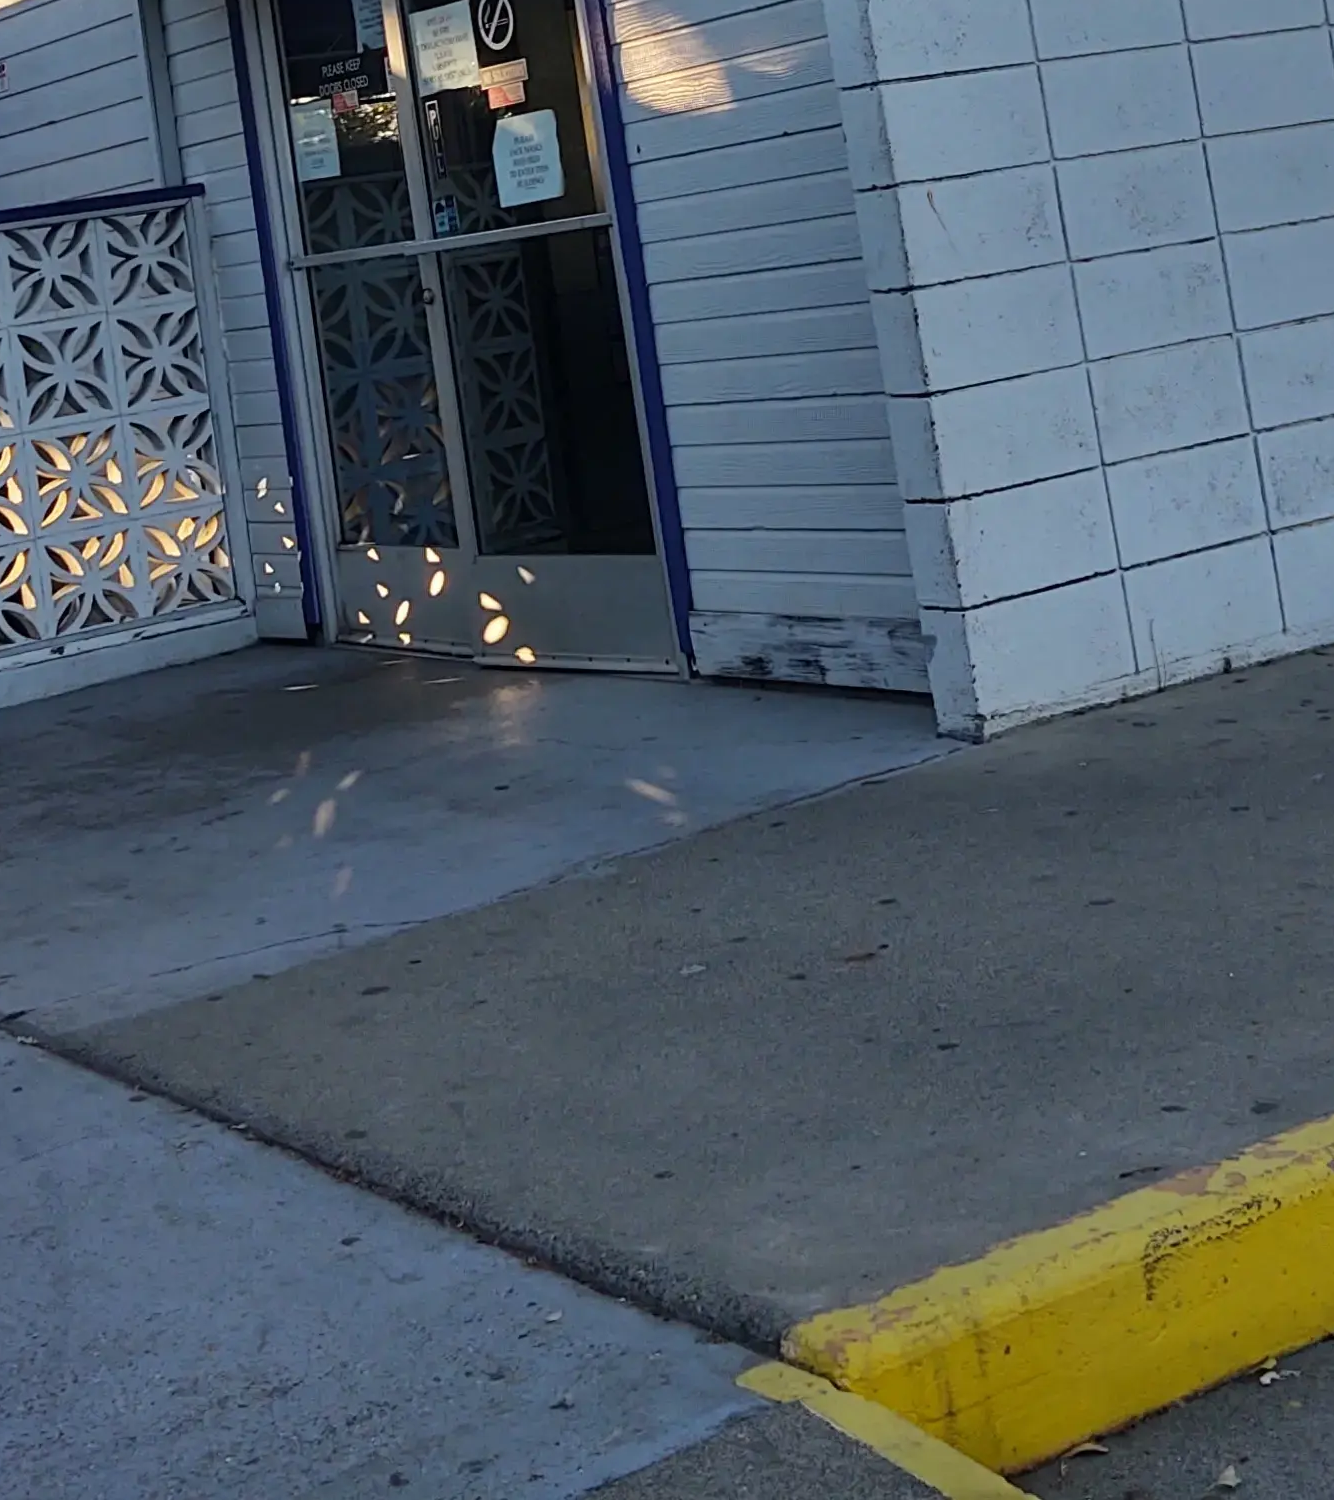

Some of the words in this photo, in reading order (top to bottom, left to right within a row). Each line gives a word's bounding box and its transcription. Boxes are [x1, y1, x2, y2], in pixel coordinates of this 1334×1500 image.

[321, 60, 345, 78] PLEASE
[345, 57, 361, 73] KEEP
[318, 80, 343, 97] DOORS
[343, 74, 369, 92] CLOSED
[428, 109, 445, 177] PULL
